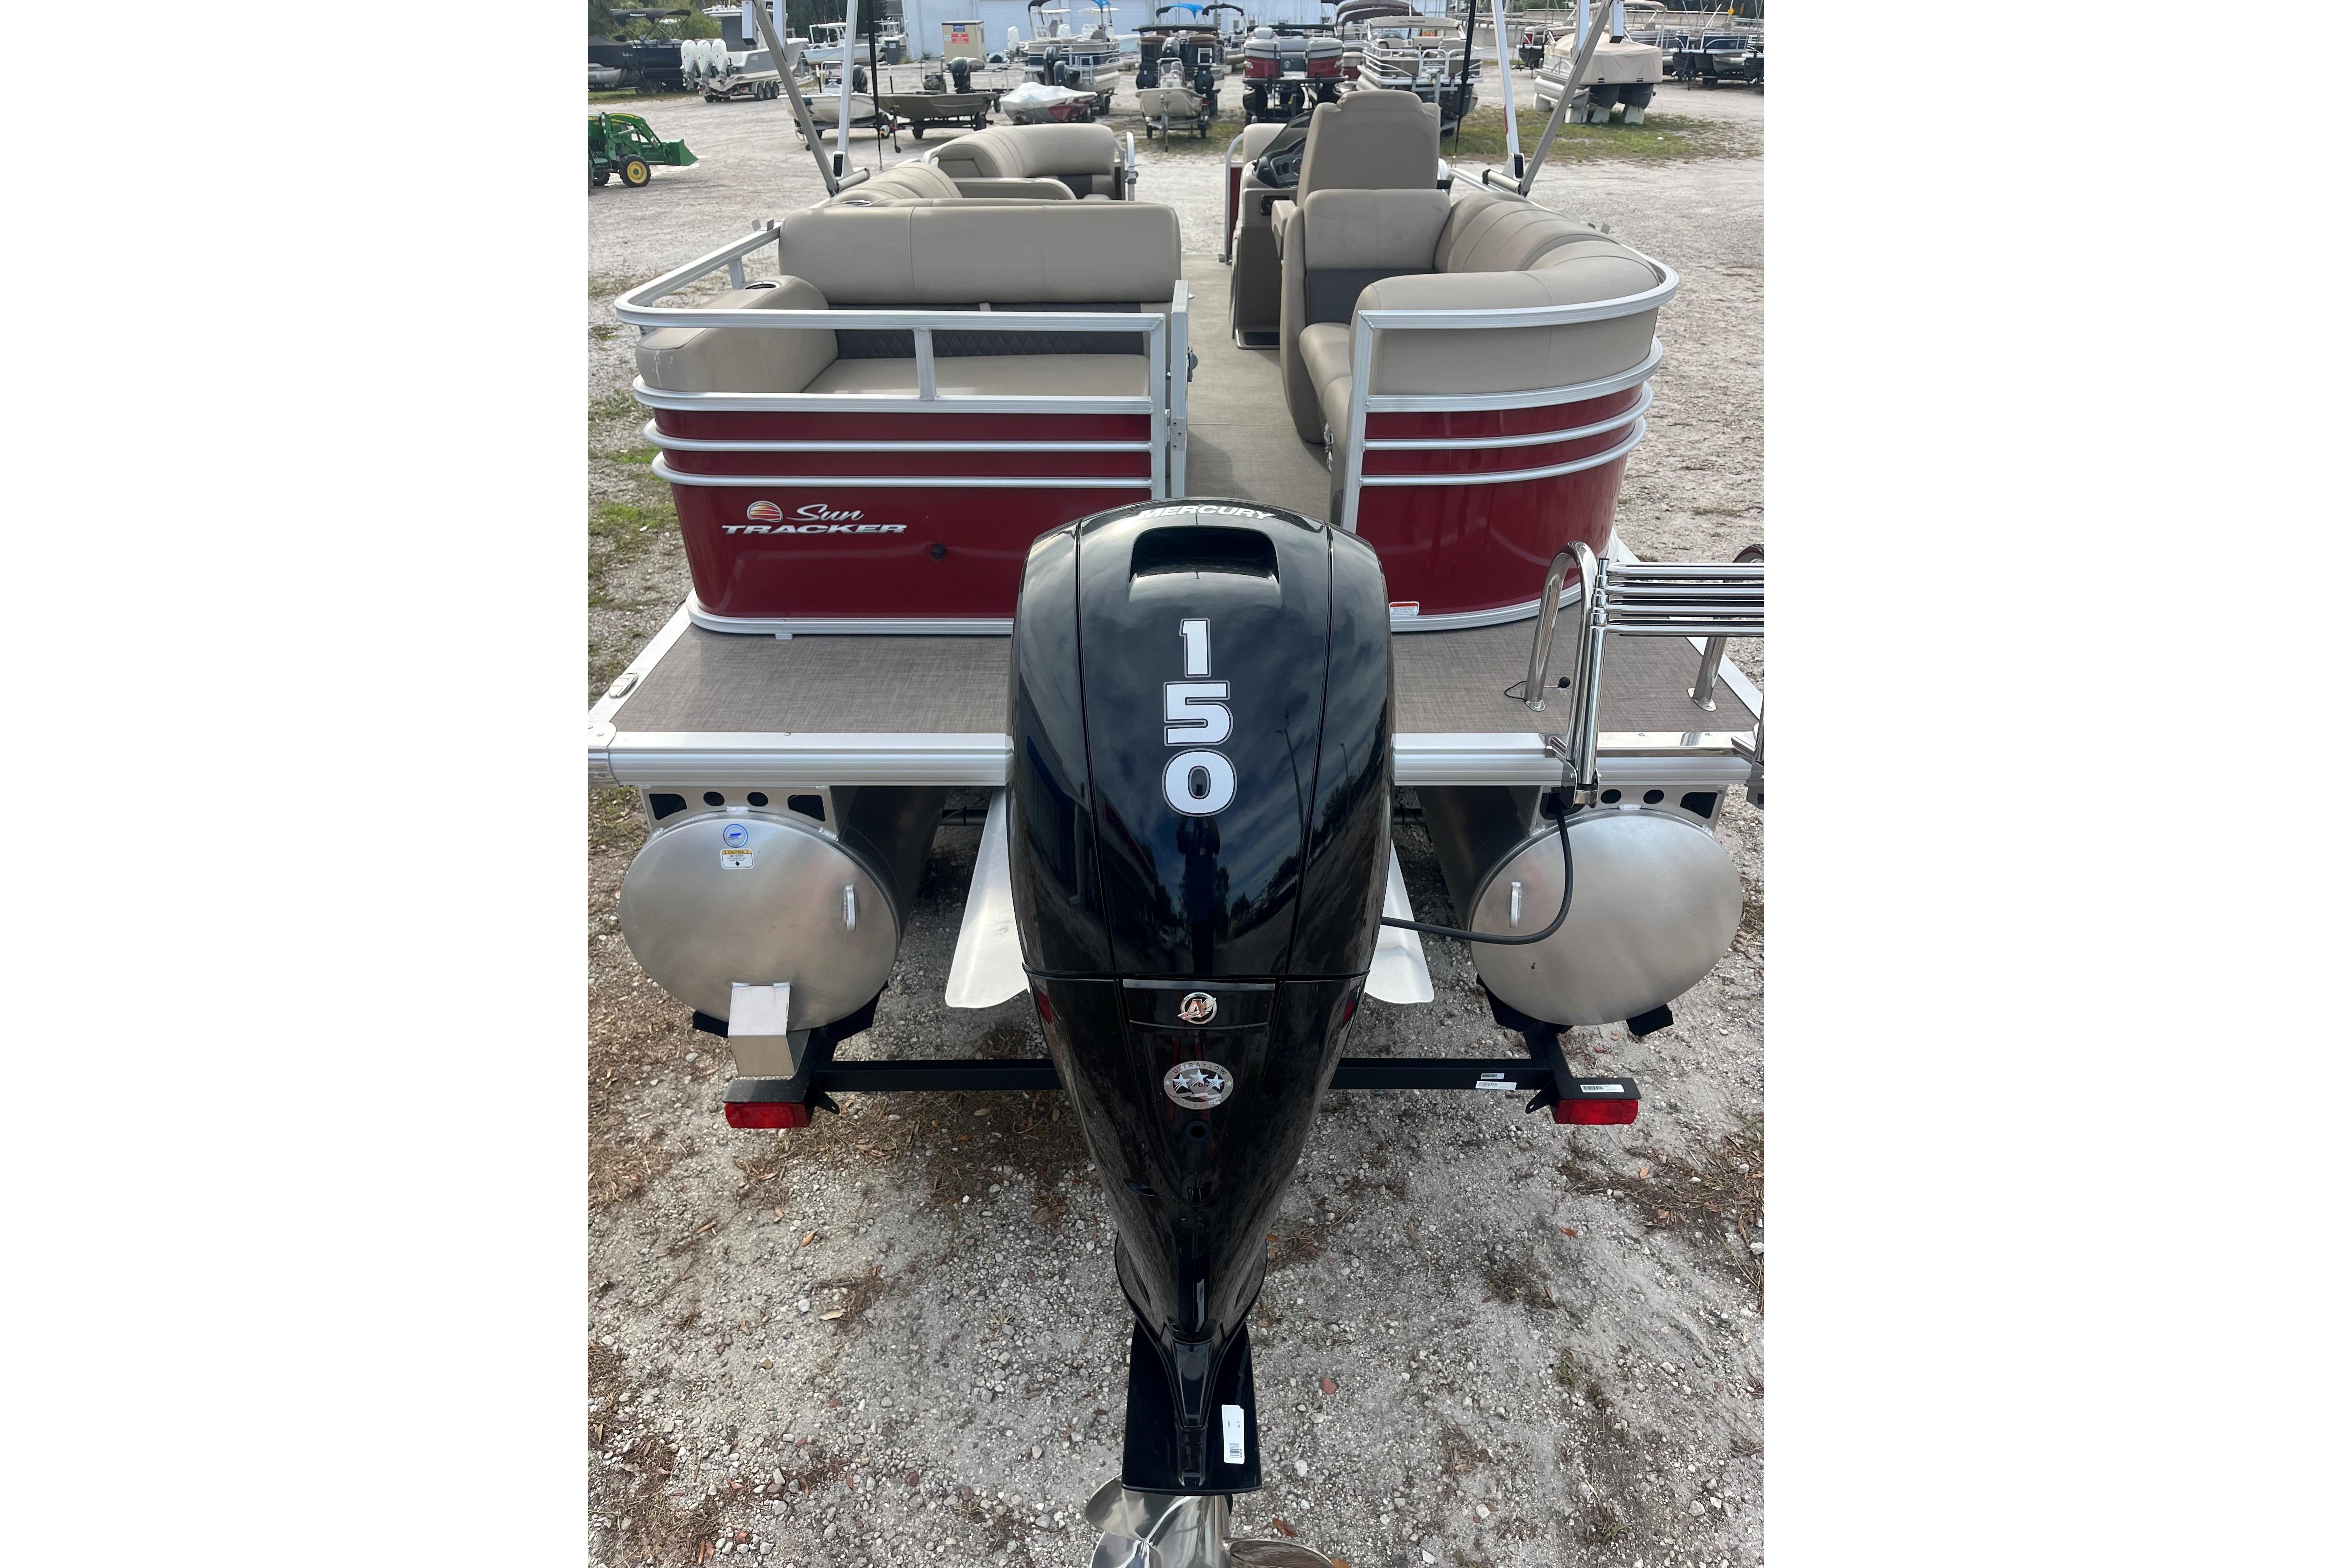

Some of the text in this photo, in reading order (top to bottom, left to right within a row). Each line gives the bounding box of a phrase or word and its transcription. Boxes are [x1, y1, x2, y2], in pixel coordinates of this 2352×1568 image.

[786, 504, 864, 521] Sun
[1137, 505, 1275, 520] MERCURY
[722, 524, 907, 535] TRACKER
